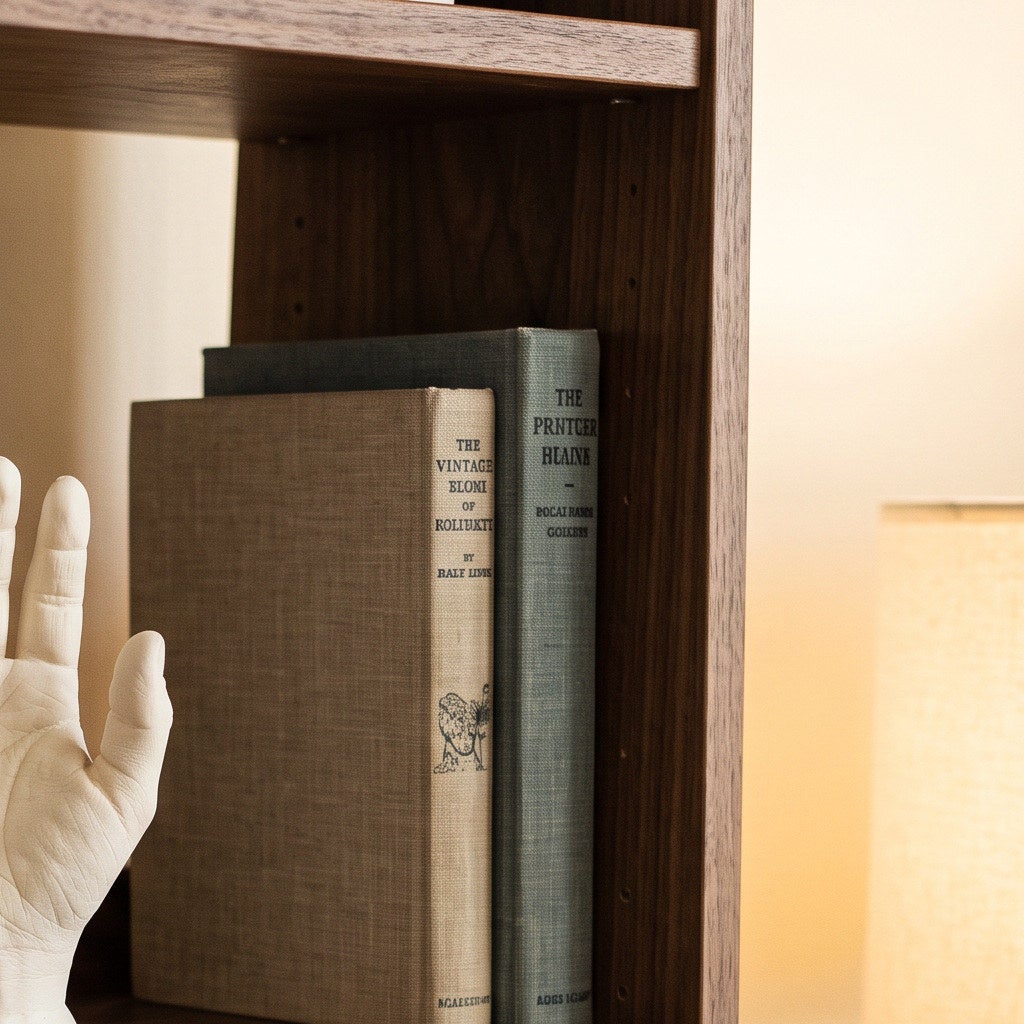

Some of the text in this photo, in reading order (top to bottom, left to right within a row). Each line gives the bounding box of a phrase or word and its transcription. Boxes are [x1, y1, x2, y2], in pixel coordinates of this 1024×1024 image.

[555, 388, 583, 408] THE
[456, 438, 481, 452] THE
[436, 459, 494, 473] VINTAGE
[461, 501, 476, 512] OF
[462, 553, 475, 562] BY
